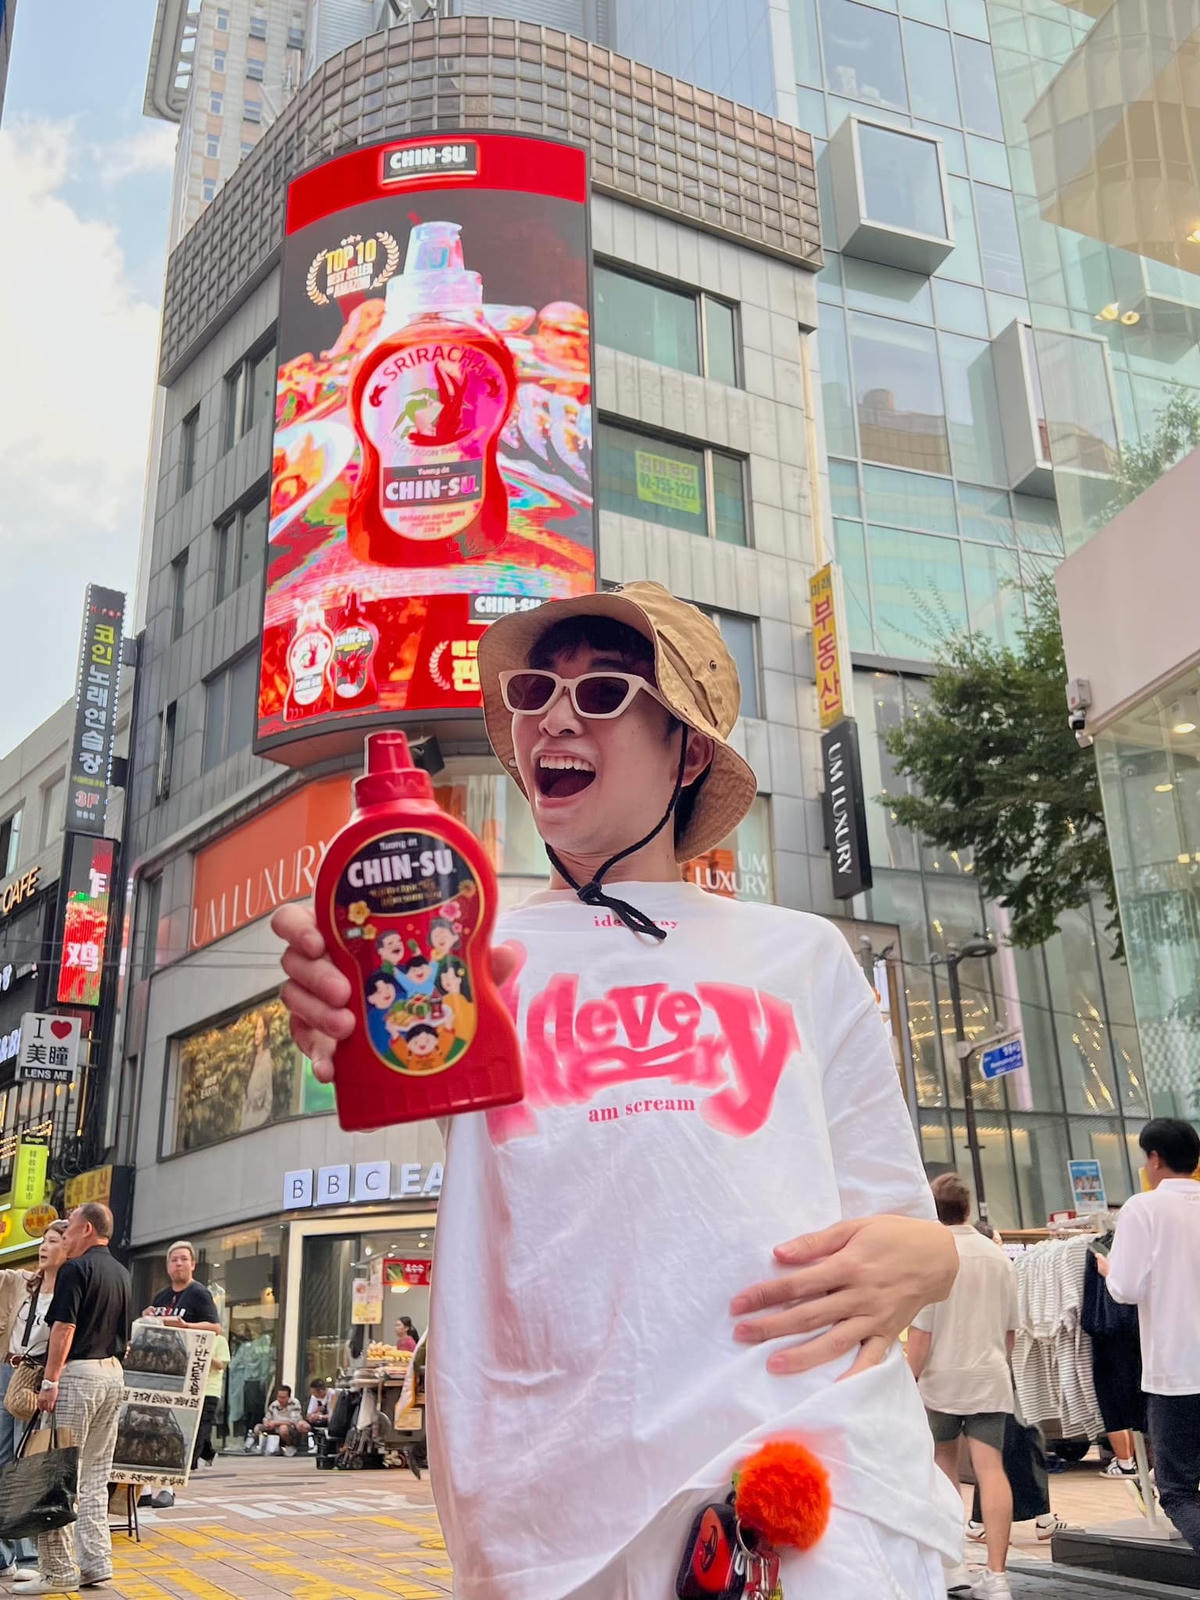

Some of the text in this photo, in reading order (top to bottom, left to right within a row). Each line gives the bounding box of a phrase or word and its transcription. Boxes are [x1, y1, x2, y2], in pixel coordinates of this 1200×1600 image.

[390, 145, 468, 169] CHIN-SU
[325, 239, 377, 275] TOP 10
[383, 345, 488, 382] SRIRACHA
[385, 475, 478, 500] CHIN-SU
[813, 596, 840, 711] 부동산
[75, 790, 99, 809] 3F
[828, 742, 852, 874] UM LUXURY
[347, 849, 455, 888] CHIN-SU
[738, 849, 768, 875] UM
[2, 867, 39, 913] CAFE
[695, 866, 769, 897] LUXURY
[26, 1044, 69, 1066] 美瞳
[25, 1069, 68, 1080] LENS ME
[589, 1098, 695, 1122] am scream
